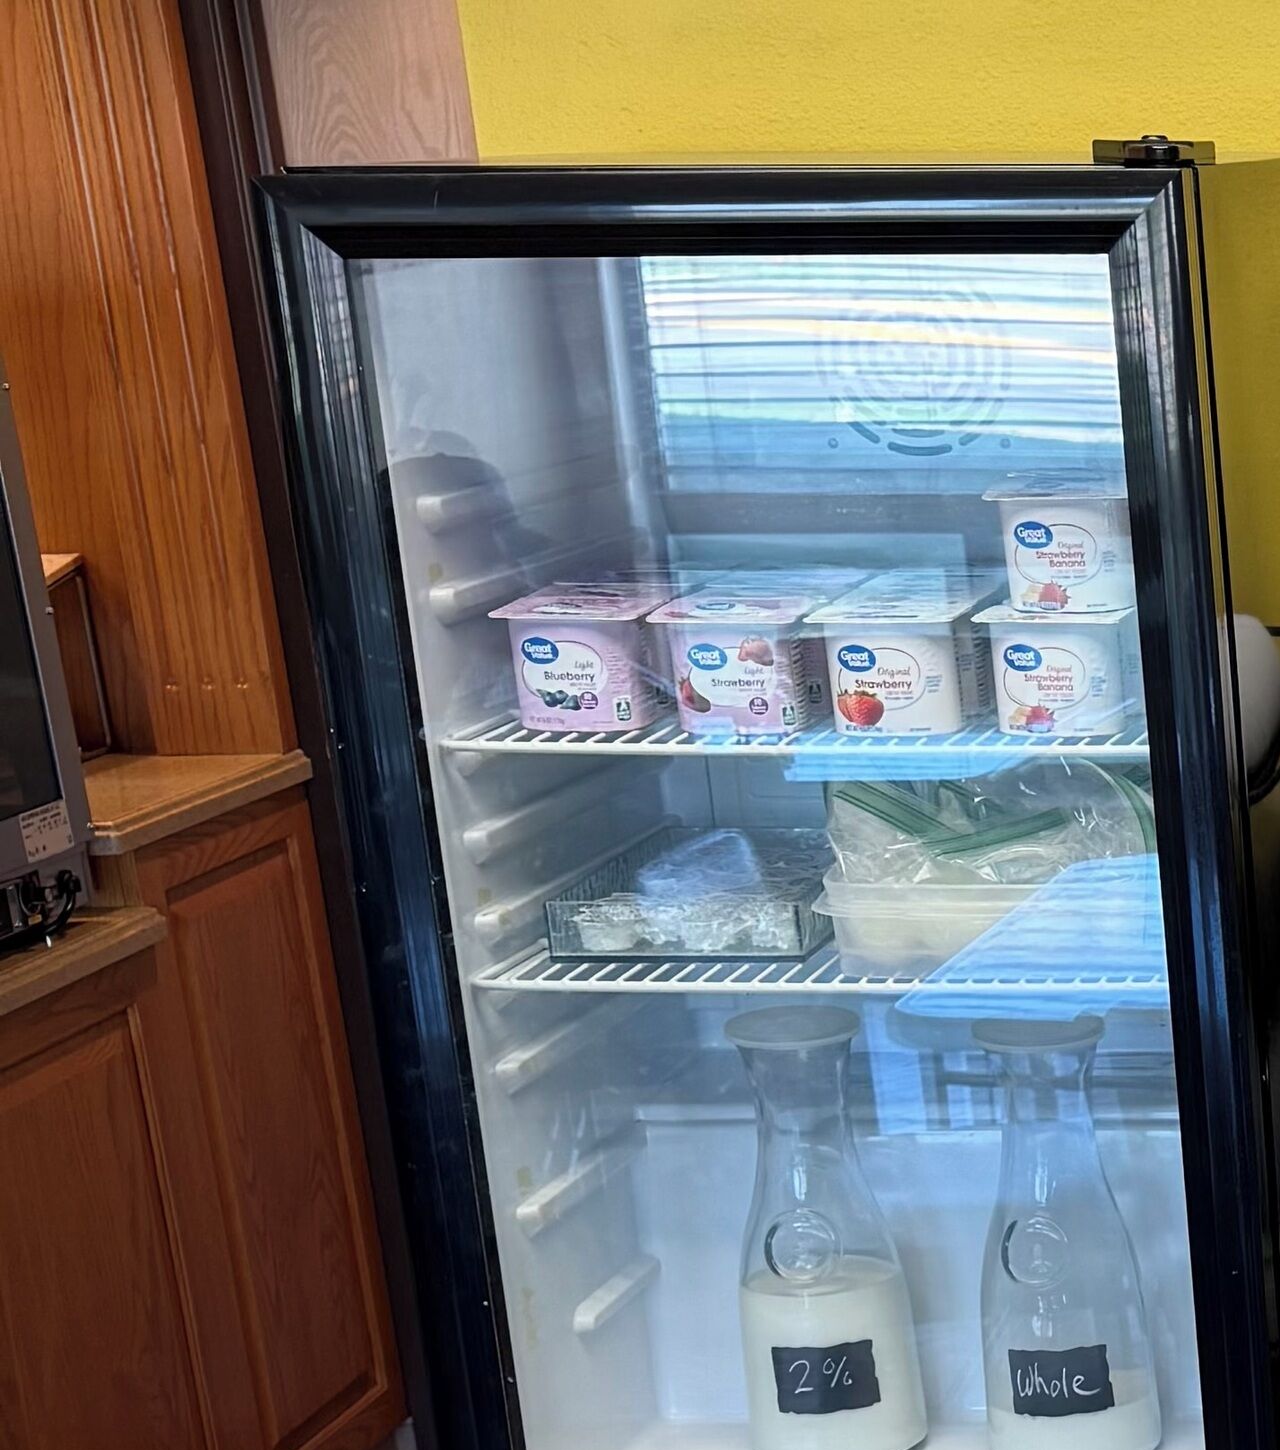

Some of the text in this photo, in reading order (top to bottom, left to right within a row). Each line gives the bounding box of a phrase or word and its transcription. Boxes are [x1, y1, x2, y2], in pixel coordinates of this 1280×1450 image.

[1017, 527, 1046, 539] Great
[1036, 551, 1085, 560] Strawberry
[1049, 559, 1086, 567] Banana
[524, 642, 552, 653] Great
[840, 651, 868, 662] Great
[1007, 649, 1035, 661] Great
[544, 671, 595, 682] Blueberry
[877, 667, 911, 679] Original
[1024, 674, 1072, 682] Strawberry
[711, 678, 765, 688] Strawberry
[855, 679, 912, 689] Strawberry
[1038, 683, 1073, 691] Banana
[787, 1355, 853, 1394] 2%
[1015, 1363, 1101, 1399] Whole
